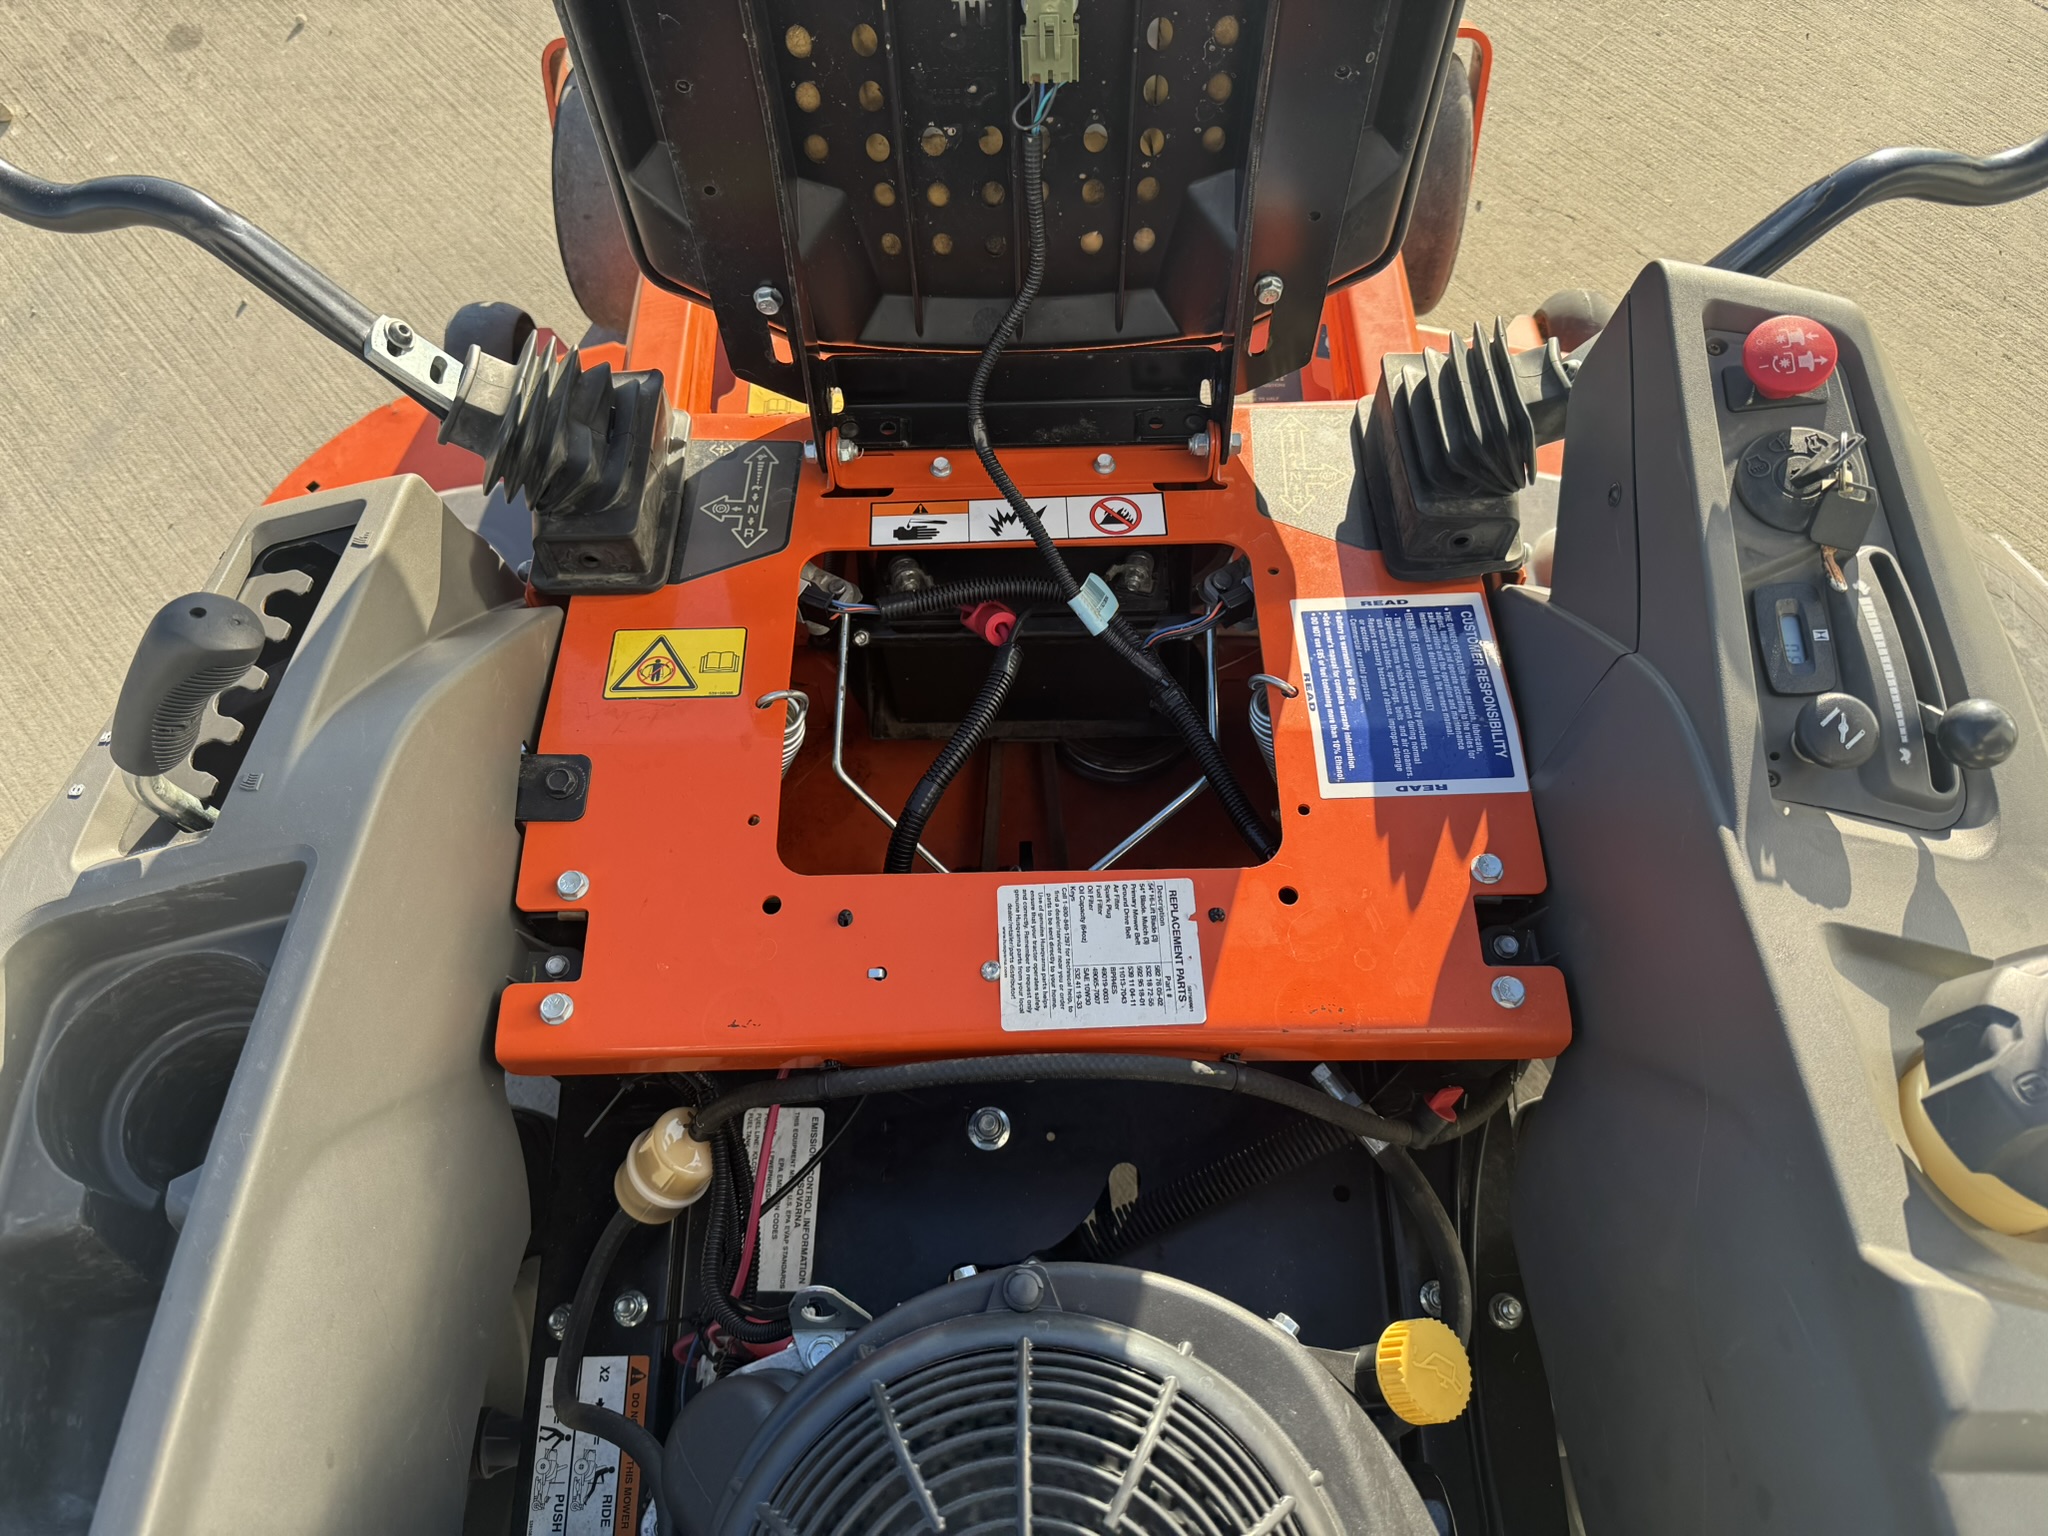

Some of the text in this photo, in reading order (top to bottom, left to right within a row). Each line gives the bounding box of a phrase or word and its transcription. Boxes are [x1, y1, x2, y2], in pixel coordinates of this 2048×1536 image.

[1290, 472, 1300, 481] N
[747, 504, 759, 514] N
[744, 529, 754, 538] R
[1310, 616, 1318, 625] DO
[1366, 617, 1377, 638] Repairs
[1375, 618, 1383, 627] use
[1393, 616, 1402, 627] Tire
[1404, 612, 1416, 629] ITEMS
[1443, 611, 1452, 621] THE
[1312, 626, 1320, 637] NOT
[1349, 618, 1362, 650] Commercial
[1359, 626, 1371, 652] accidents.
[1378, 629, 1387, 641] such
[1408, 630, 1418, 641] NOT
[1370, 639, 1383, 665] necessary
[1395, 628, 1410, 661] replacement
[1411, 642, 1425, 668] COVERED
[1445, 623, 1465, 674] OWNER/OPERATOR
[1334, 615, 1345, 634] Battery
[1340, 641, 1352, 668] warranted
[1347, 686, 1358, 700] days.
[1357, 658, 1367, 674] rental
[1382, 649, 1393, 670] blades,
[1319, 667, 1327, 677] fuel
[1376, 667, 1388, 689] because
[1386, 671, 1396, 686] spark
[1404, 669, 1416, 688] repairs
[1459, 675, 1471, 694] should
[1460, 611, 1508, 757] CUSTOMER RESPONSIBILITY
[1303, 673, 1317, 712] READ
[1304, 673, 1315, 711] READ
[1320, 678, 1333, 707] containing
[1322, 616, 1358, 770] See manual for complete warranty information.
[1359, 675, 1371, 702] purposes.
[1383, 617, 1422, 763] Expendable items which become worn during normal
[1389, 687, 1401, 704] plugs,
[1409, 690, 1421, 709] caused
[1419, 678, 1435, 711] WARRANTY
[1326, 708, 1335, 723] more
[1382, 697, 1394, 716] abuse,
[1394, 706, 1404, 720] belts
[1329, 724, 1339, 738] than
[1386, 718, 1400, 745] improper
[1398, 724, 1407, 736] and
[1400, 738, 1408, 746] air
[1414, 719, 1430, 751] punctures.
[1469, 723, 1486, 754] lubricate,
[1331, 739, 1341, 754] 10%
[1390, 747, 1404, 771] storage
[1333, 755, 1346, 782] Ethanol.
[1401, 748, 1415, 778] cleaners.
[1396, 784, 1448, 792] READ
[1129, 883, 1137, 908] Primary
[1156, 885, 1166, 926] Description
[1078, 895, 1086, 923] Capacity
[1168, 890, 1186, 1001] REPLACEMENT PARTS
[790, 1128, 798, 1167] EQUIPMENT
[803, 1170, 814, 1214] CONTROL
[771, 1213, 779, 1239] CODES
[798, 1217, 810, 1284] INFORMATION
[779, 1246, 788, 1289] STANDARDS
[599, 1366, 610, 1382] X2
[632, 1392, 640, 1408] DO
[626, 1462, 634, 1488] THIS
[552, 1494, 565, 1532] PUSH
[600, 1495, 613, 1528] RIDE
[621, 1489, 633, 1530] MOWER
